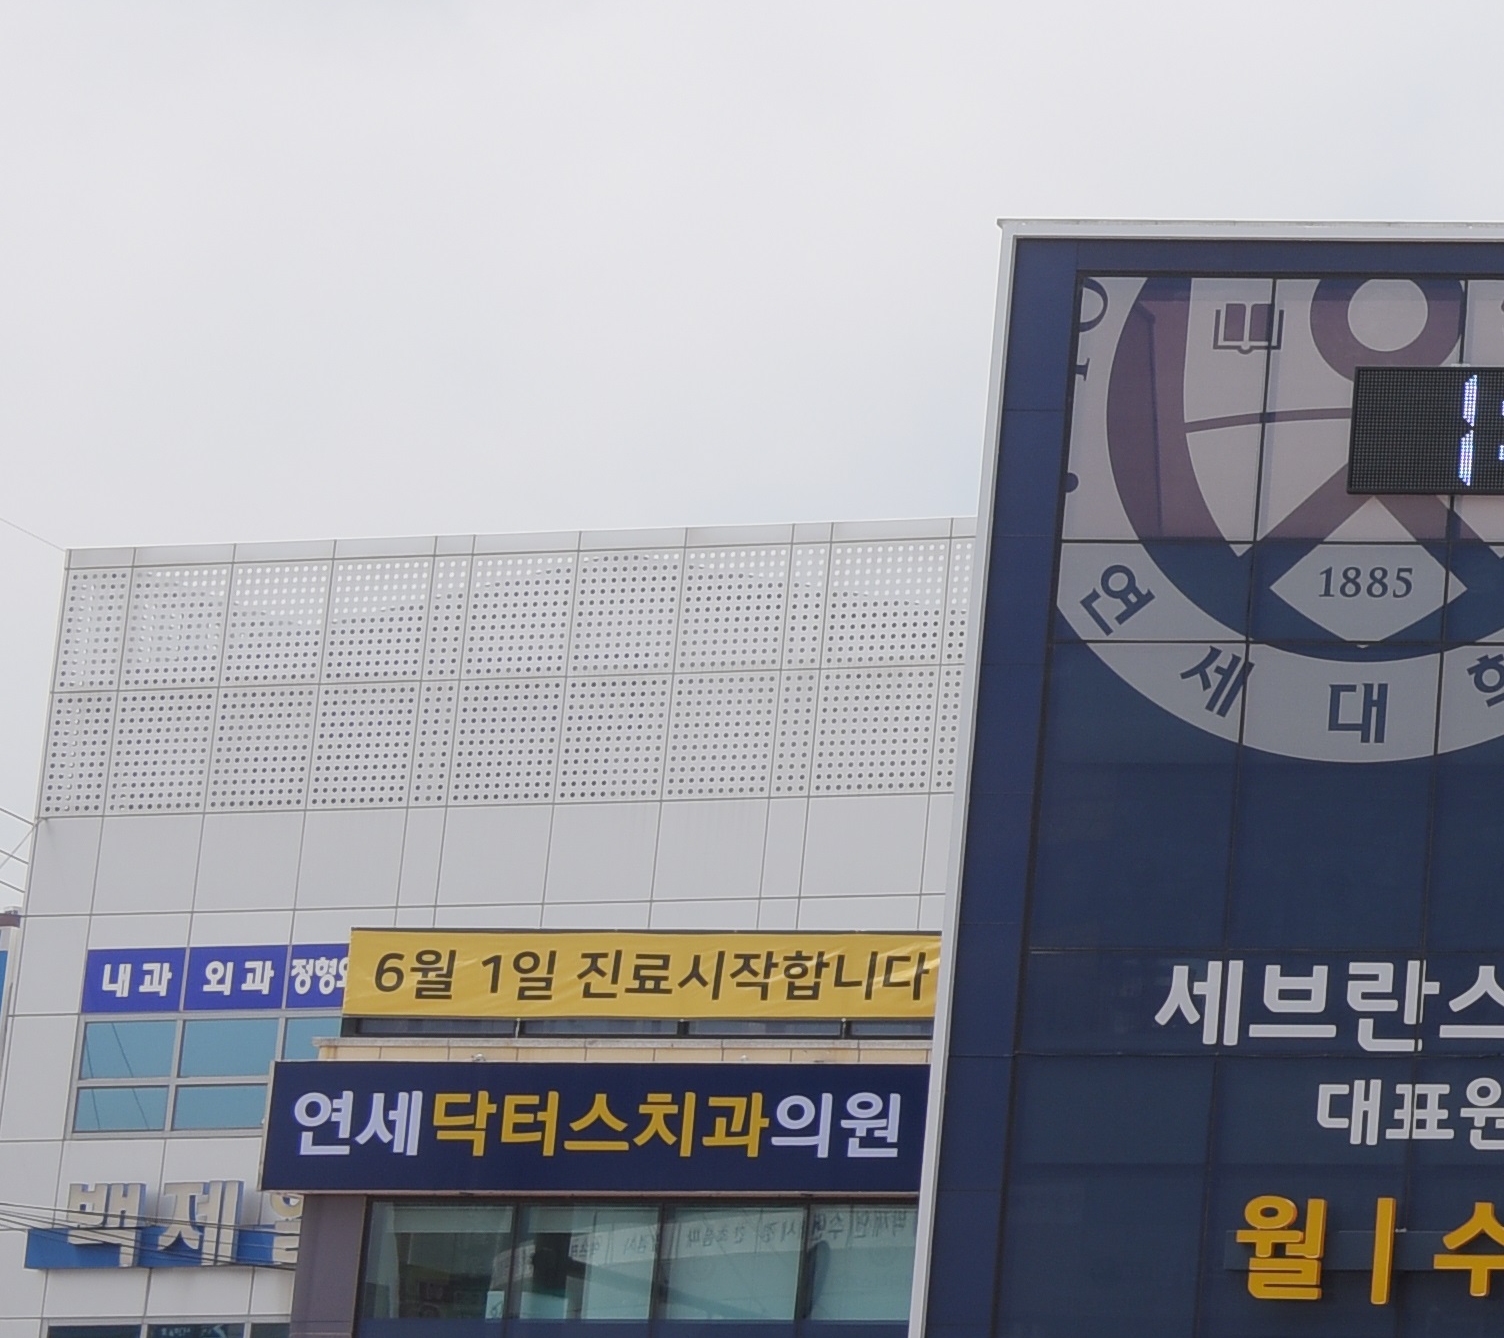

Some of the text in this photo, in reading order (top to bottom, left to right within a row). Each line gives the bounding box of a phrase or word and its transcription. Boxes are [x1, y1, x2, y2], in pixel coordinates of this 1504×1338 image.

[1317, 565, 1415, 600] 1885
[101, 960, 172, 999] 내과
[201, 959, 274, 997] 외과
[374, 947, 931, 1002] 6월 1일 진료시작합니다
[293, 1088, 901, 1160] 연세닥터스치과의원
